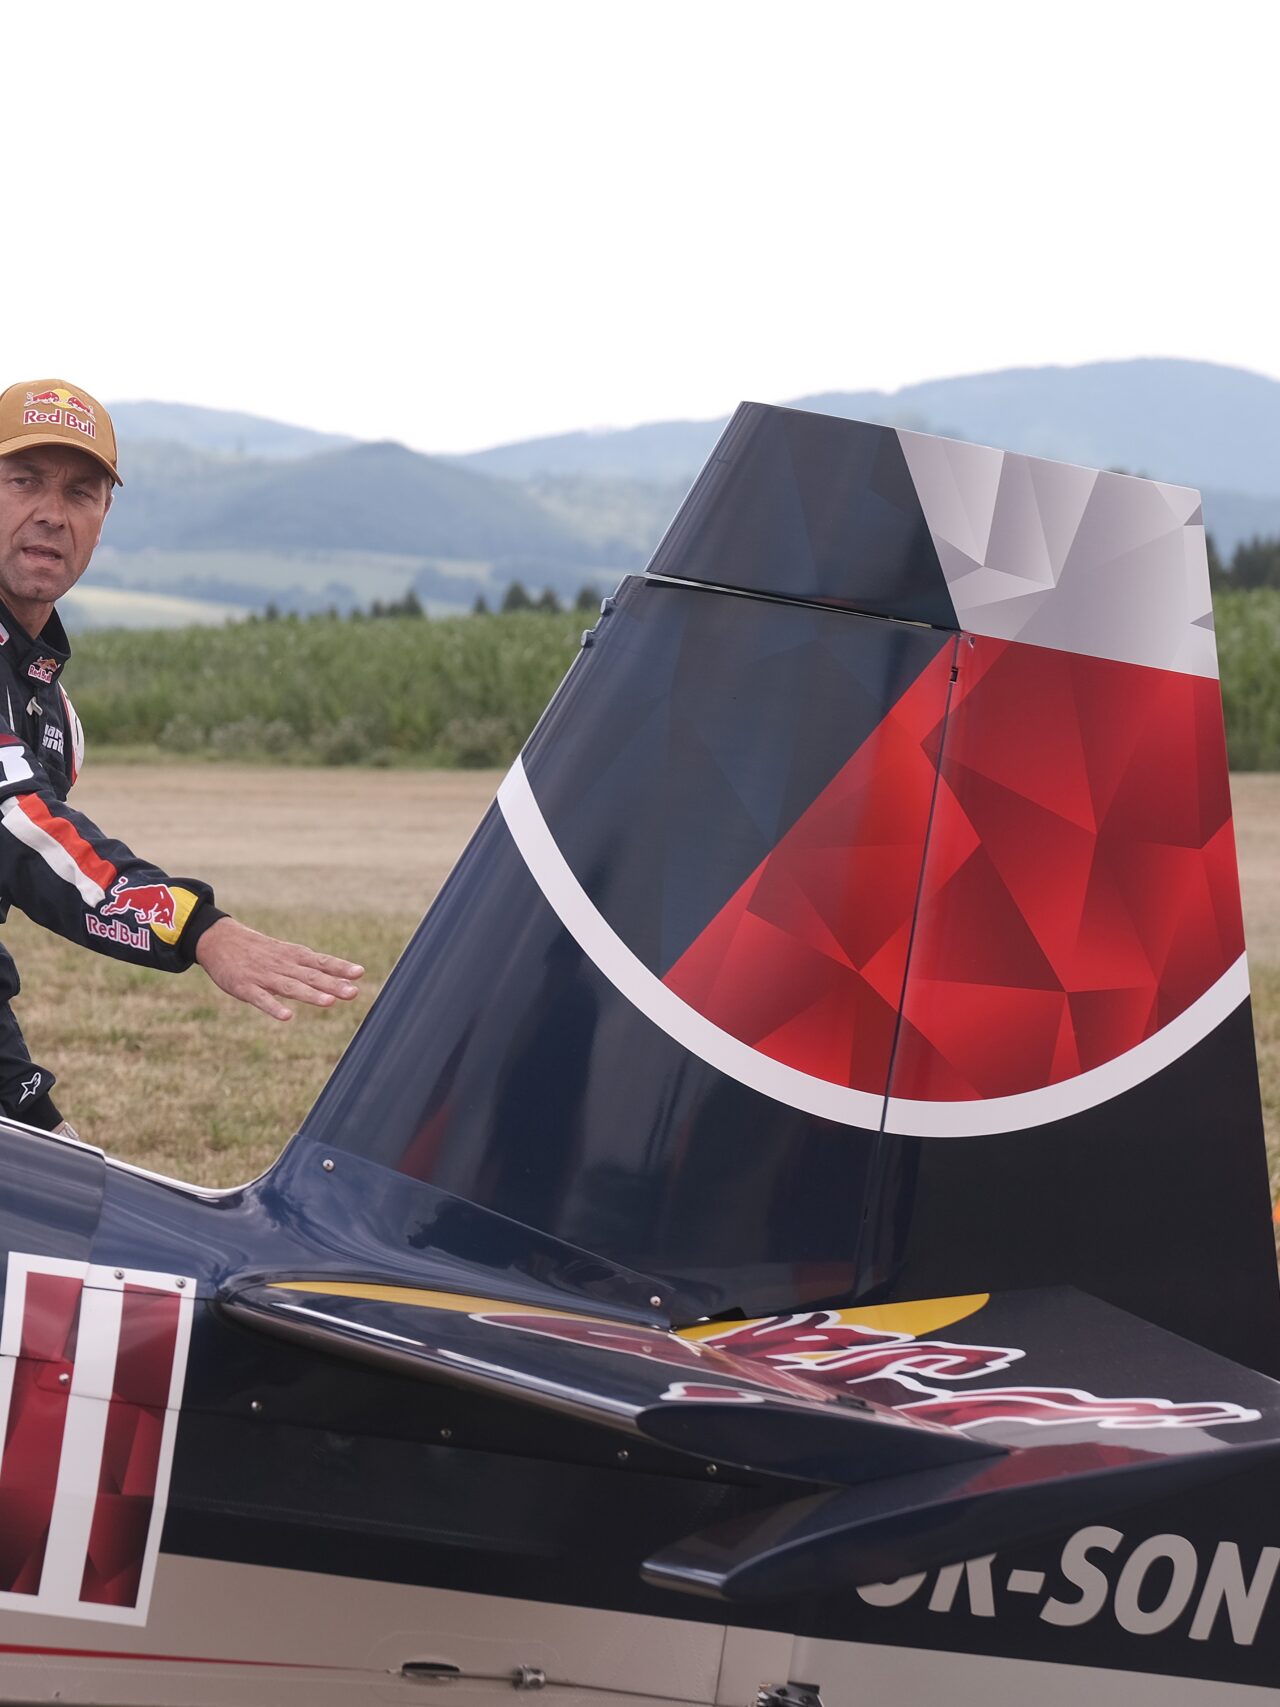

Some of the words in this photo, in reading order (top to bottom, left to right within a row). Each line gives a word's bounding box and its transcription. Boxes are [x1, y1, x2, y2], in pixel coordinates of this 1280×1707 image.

[23, 409, 61, 424] Red
[65, 411, 96, 439] Bull
[86, 914, 119, 940] Red
[120, 921, 150, 951] Bull
